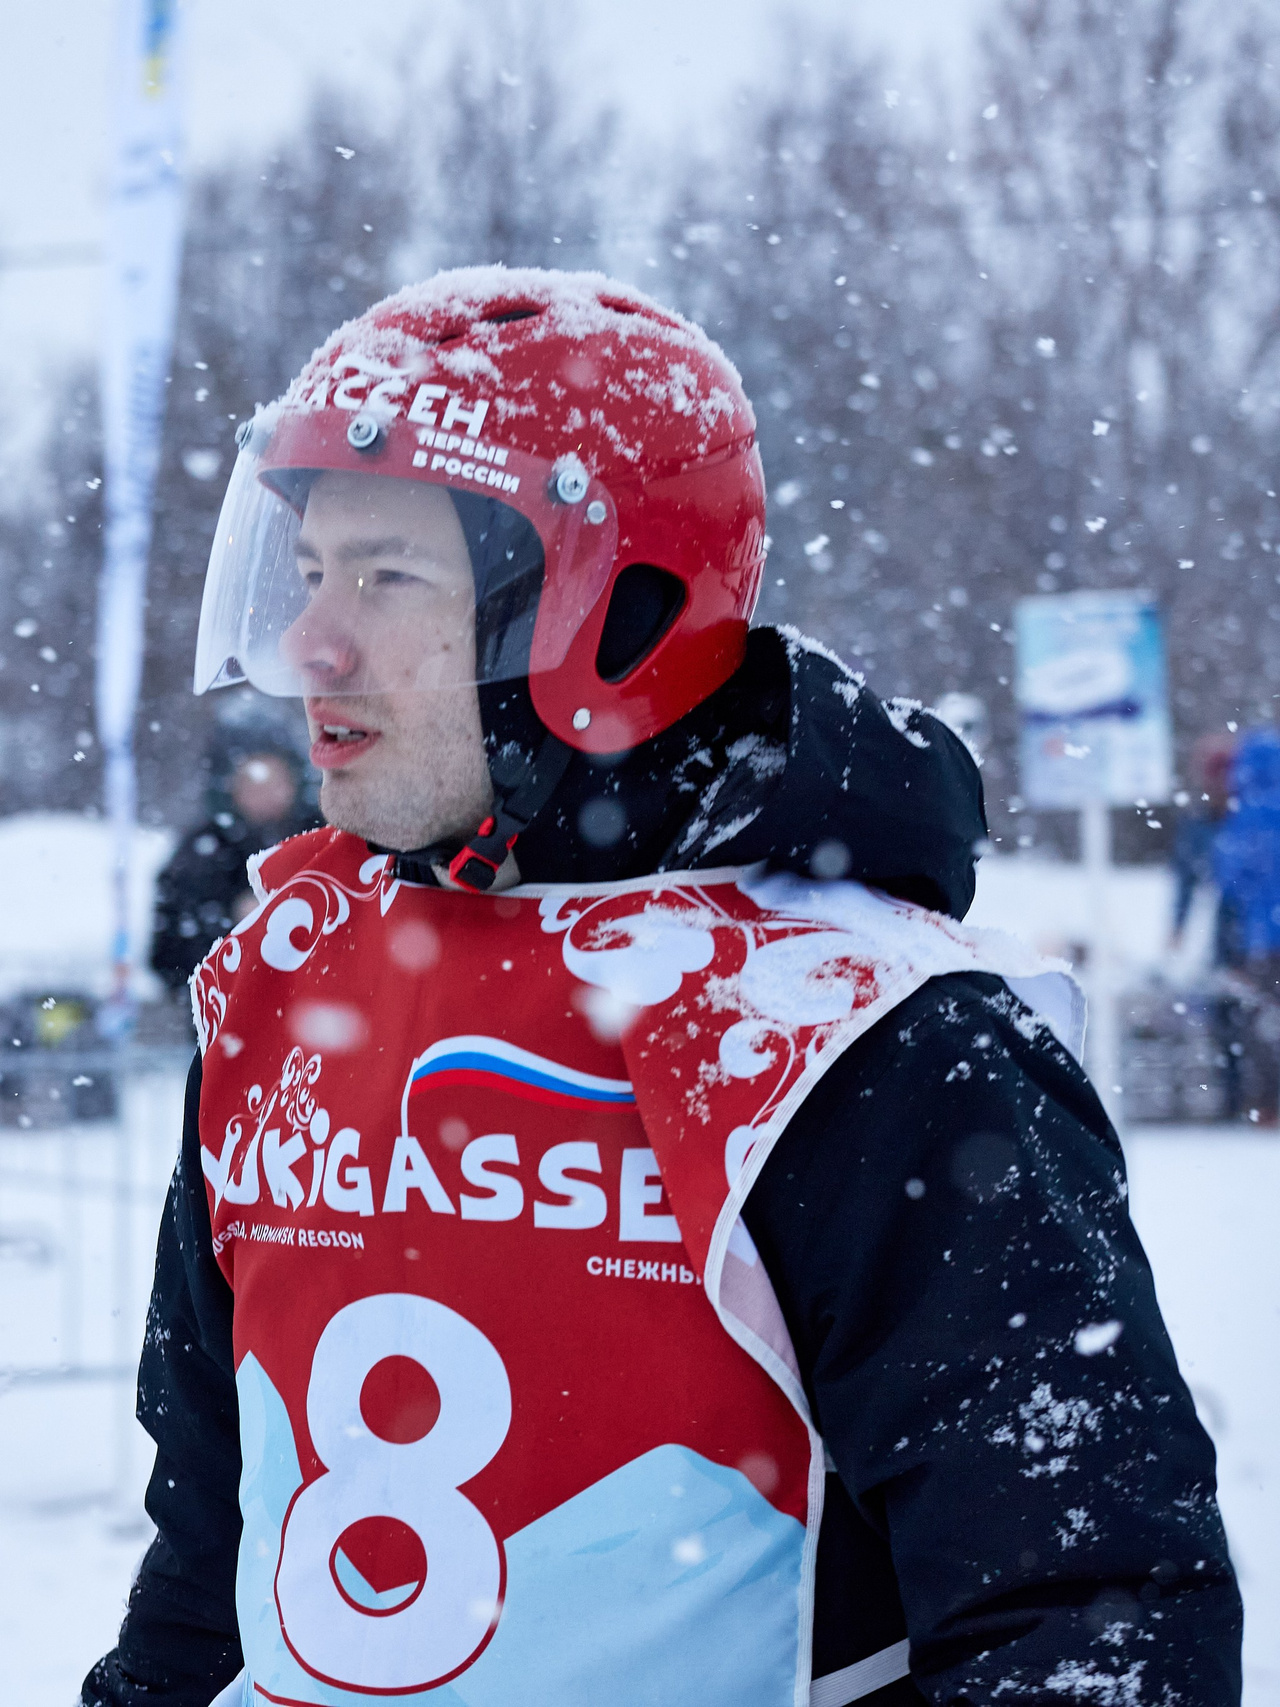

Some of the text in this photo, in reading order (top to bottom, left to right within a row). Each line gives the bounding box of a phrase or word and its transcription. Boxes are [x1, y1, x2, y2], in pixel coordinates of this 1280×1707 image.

[412, 450, 520, 494] В РОССИИ
[212, 1220, 365, 1257] USSIA, MURMANSK REGION
[275, 1292, 512, 1692] 8
